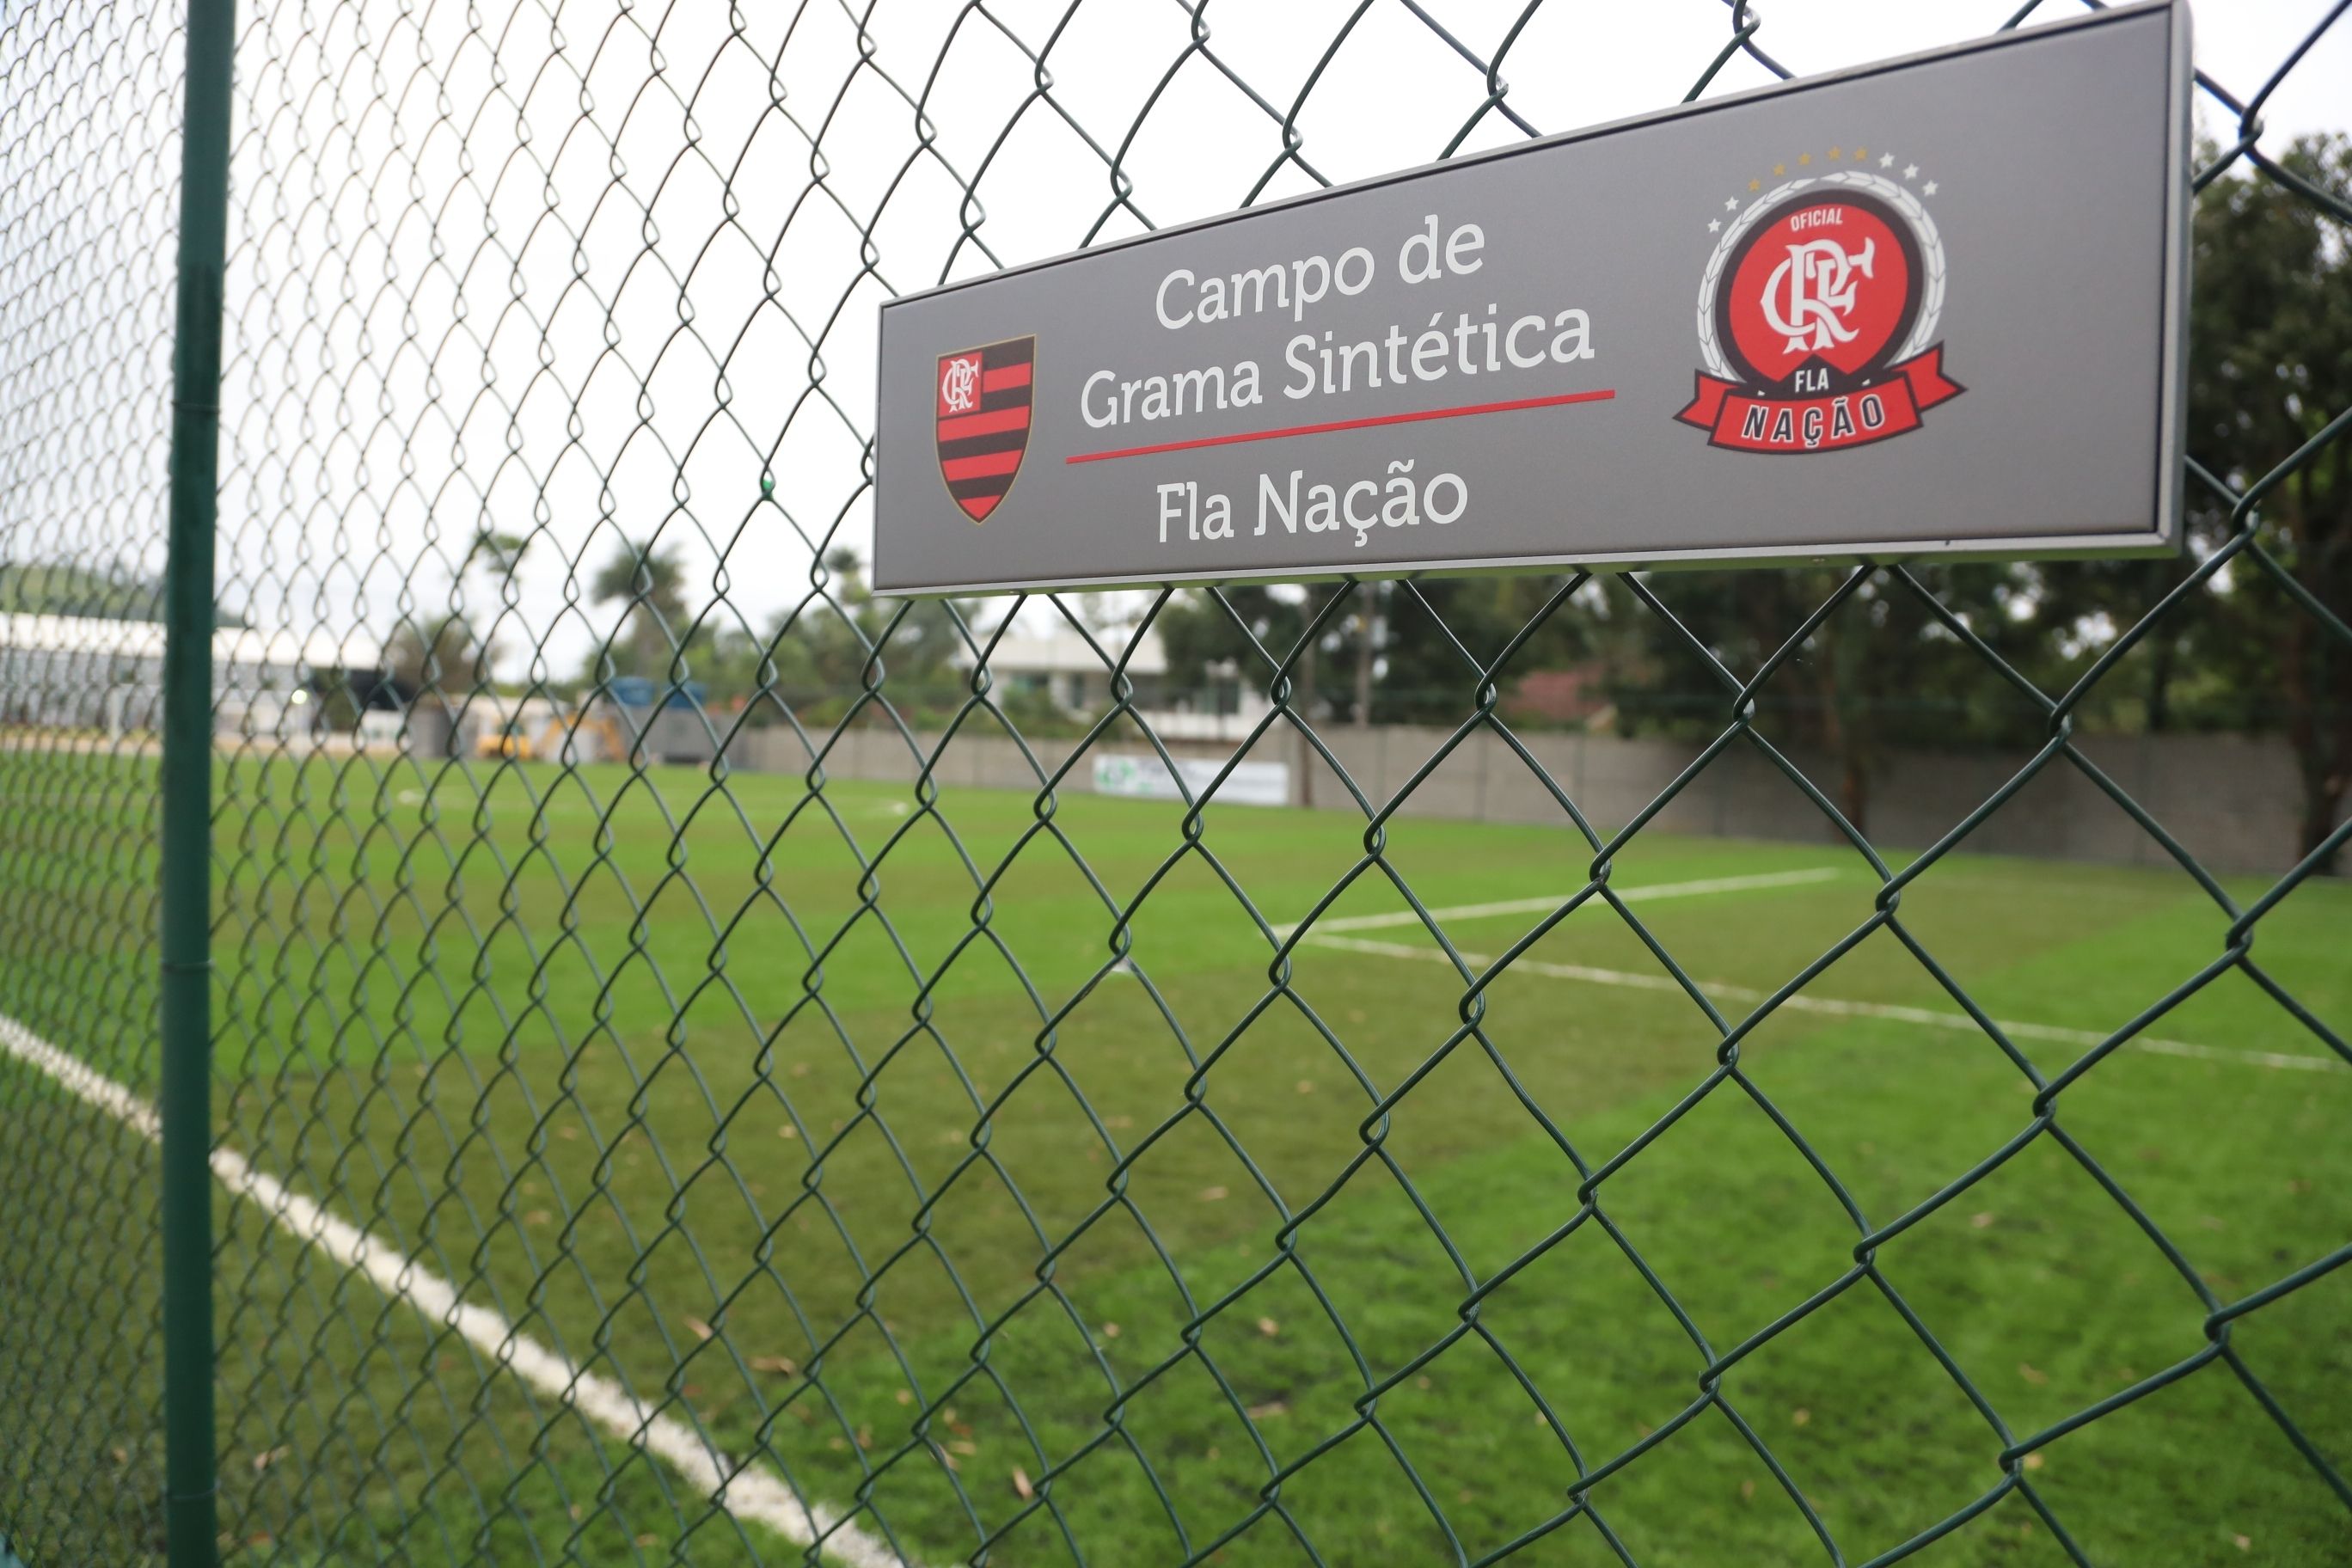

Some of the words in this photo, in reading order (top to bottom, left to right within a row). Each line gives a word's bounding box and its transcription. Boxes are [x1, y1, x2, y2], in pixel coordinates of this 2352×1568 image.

[1790, 208, 1843, 231] OFICIAL
[1155, 246, 1375, 330] Campo
[1399, 214, 1485, 285] de
[1081, 360, 1263, 428] Grama
[1283, 303, 1596, 400] Sintética
[1794, 367, 1829, 394] FLA
[1741, 394, 1886, 449] NAÇÃO
[1156, 481, 1234, 543] Fla
[1253, 458, 1468, 548] Nação
